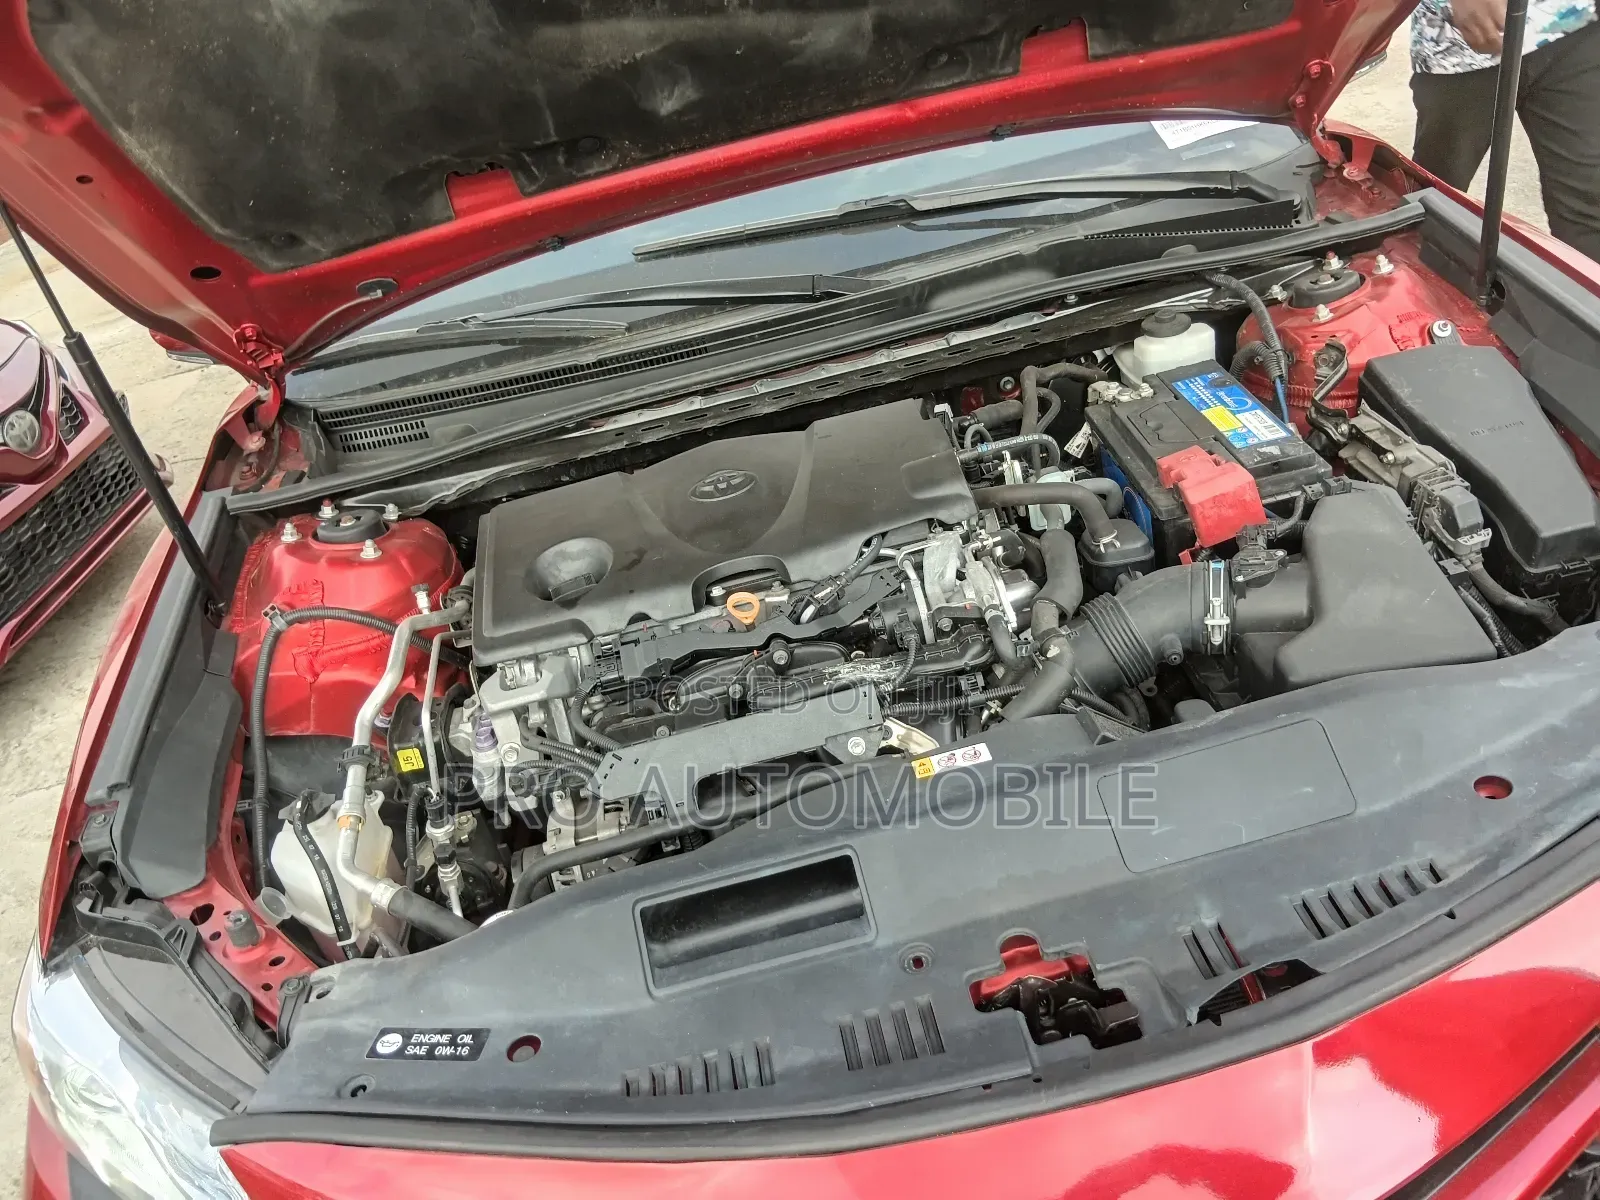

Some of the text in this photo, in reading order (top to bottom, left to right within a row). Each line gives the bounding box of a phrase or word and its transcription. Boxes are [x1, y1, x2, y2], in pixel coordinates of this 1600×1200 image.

[410, 1034, 474, 1044] ENGINE OIL
[404, 1045, 470, 1056] SAE 0W-16
